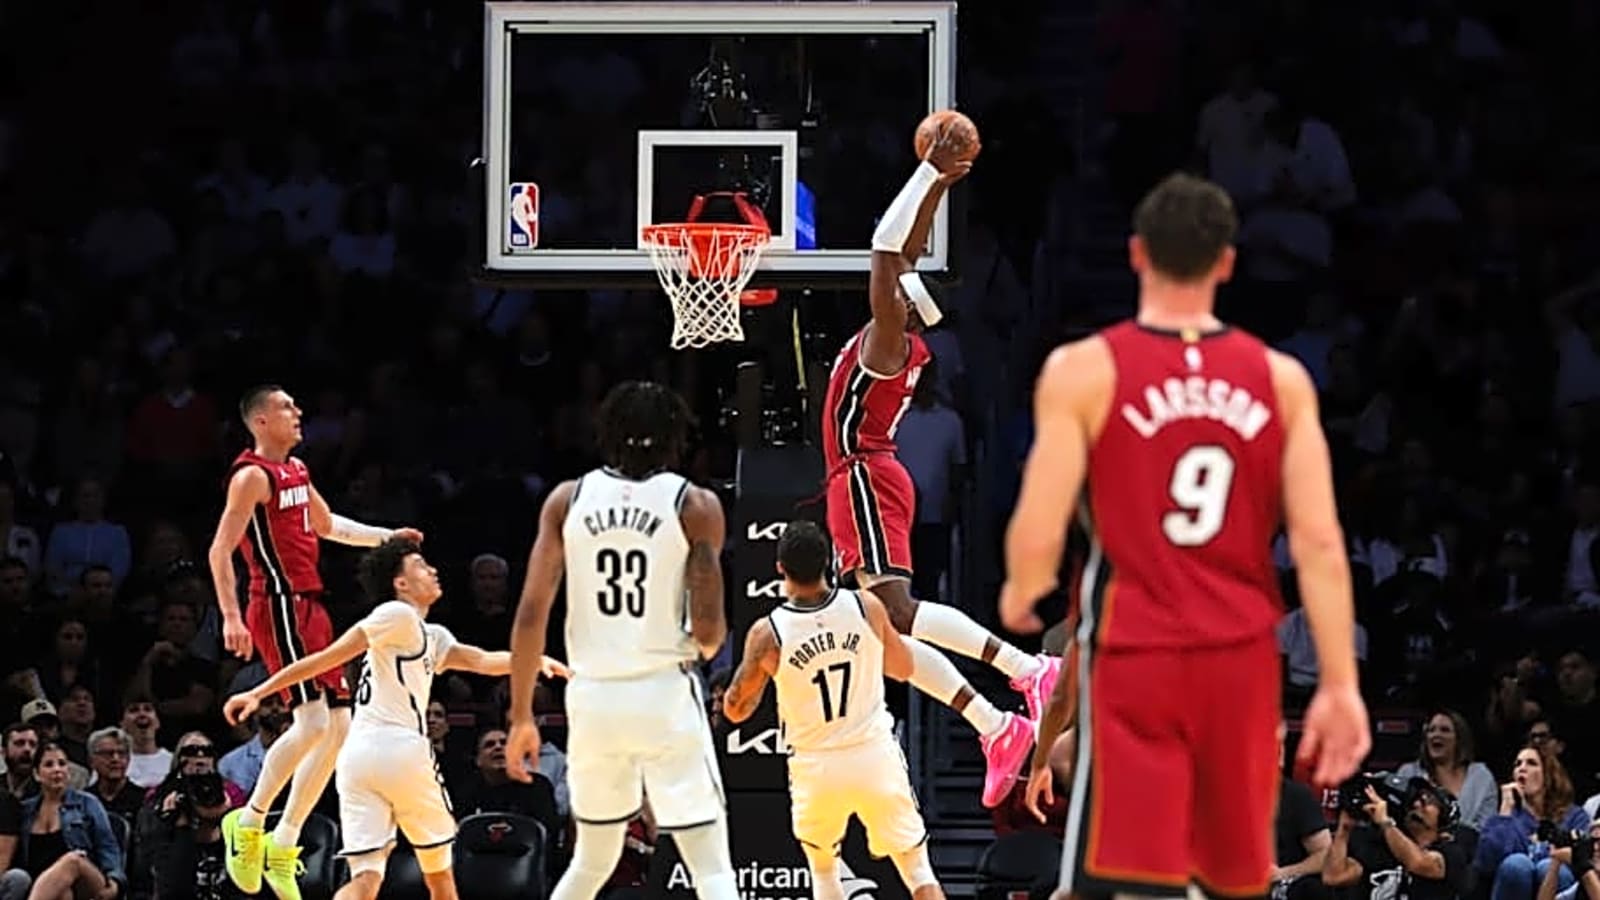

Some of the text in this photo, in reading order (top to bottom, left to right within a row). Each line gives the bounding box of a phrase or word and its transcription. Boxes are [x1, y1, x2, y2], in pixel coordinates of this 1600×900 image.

[1122, 375, 1271, 440] LARSSON
[1162, 444, 1236, 546] 9
[584, 506, 663, 537] CLAXTON
[747, 521, 788, 540] KI
[596, 548, 648, 618] 33
[747, 579, 788, 598] KI
[788, 631, 861, 671] PORTER JR.
[811, 660, 851, 723] 17
[727, 730, 788, 754] KI
[667, 861, 811, 889] Arican
